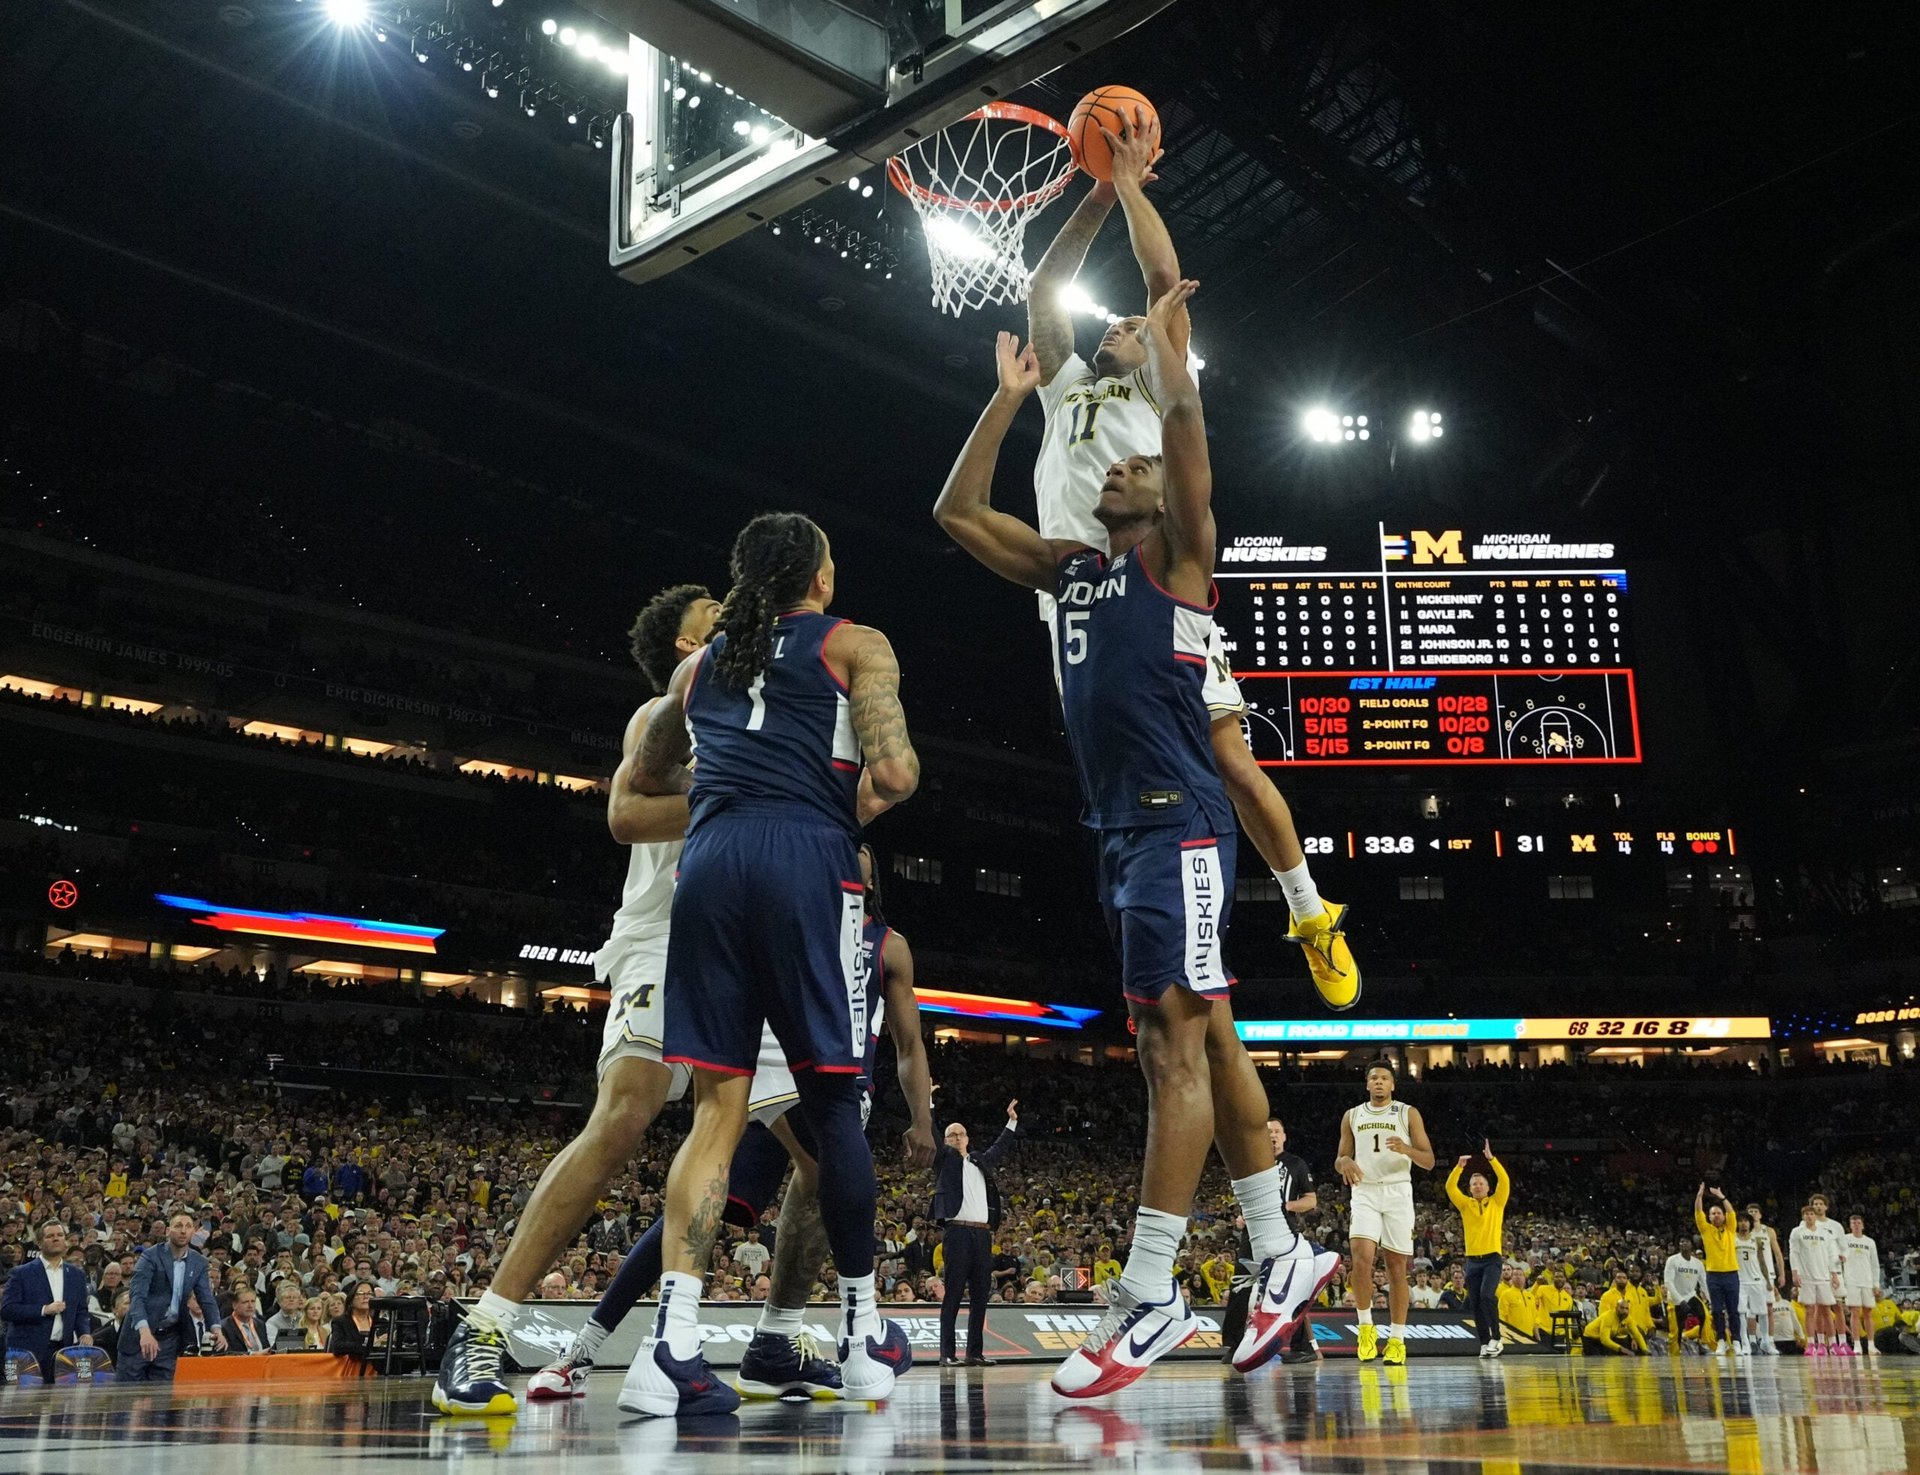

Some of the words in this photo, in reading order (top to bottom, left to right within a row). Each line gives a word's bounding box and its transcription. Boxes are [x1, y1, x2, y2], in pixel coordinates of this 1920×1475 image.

[1069, 402, 1100, 447] 11
[1234, 536, 1283, 547] UCONN
[1483, 534, 1550, 544] MICHIGAN
[1411, 531, 1464, 564] M
[1473, 544, 1614, 559] WOLVERINES
[1222, 547, 1327, 562] HUSKIES
[1250, 583, 1265, 591] PTS
[1340, 582, 1355, 590] BLK
[1536, 580, 1551, 588] AST
[1558, 580, 1573, 588] STL
[1254, 597, 1263, 605] 4
[1276, 596, 1285, 605] 3
[1299, 596, 1307, 605] 3
[1321, 596, 1330, 605] 0
[1344, 596, 1353, 605] 0
[1367, 596, 1373, 604] 1
[1401, 596, 1405, 604] 1
[1417, 595, 1483, 604] MCKENNEY
[1495, 595, 1503, 603] 0
[1517, 594, 1525, 603] 5
[1541, 594, 1547, 603] 1
[1562, 594, 1571, 603] 0
[1584, 594, 1593, 603] 0
[1607, 593, 1616, 602] 0
[1277, 611, 1286, 620] 0
[1300, 611, 1308, 620] 0
[1322, 611, 1331, 620] 0
[1345, 611, 1354, 619] 0
[1367, 610, 1375, 619] 2
[1401, 611, 1408, 619] 11
[1417, 610, 1456, 619] GAYLE
[1457, 610, 1474, 619] JR.
[1496, 609, 1504, 618] 2
[1519, 609, 1525, 618] 1
[1541, 609, 1550, 618] 0
[1563, 609, 1572, 618] 0
[1587, 609, 1593, 617] 1
[1608, 608, 1617, 617] 0
[1256, 627, 1264, 635] 4
[1278, 626, 1286, 635] 6
[1300, 626, 1309, 635] 0
[1323, 626, 1332, 635] 0
[1346, 626, 1354, 634] 0
[1368, 625, 1376, 634] 2
[1400, 625, 1411, 634] 15
[1419, 625, 1455, 634] MARA
[1520, 624, 1528, 633] 2
[1543, 624, 1550, 633] 1
[1565, 624, 1574, 633] 0
[1589, 624, 1595, 632] 1
[1610, 623, 1619, 632] 0
[1065, 611, 1090, 665] 5
[1401, 640, 1412, 649] 21
[1419, 640, 1476, 649] JOHNSON
[1477, 640, 1493, 649] JR.
[1497, 639, 1509, 648] 10
[1521, 639, 1530, 648] 4
[1544, 639, 1553, 648] 0
[1567, 639, 1573, 648] 1
[1589, 638, 1598, 647] 0
[1613, 638, 1619, 647] 1
[32, 624, 112, 653] EDGERRIN
[116, 644, 168, 665] JAMES
[177, 656, 234, 678] 1999-05
[1279, 641, 1287, 650] 4
[1303, 641, 1308, 650] 1
[1324, 641, 1333, 650] 0
[1346, 641, 1355, 650] 0
[1370, 641, 1376, 649] 1
[1257, 657, 1265, 666] 3
[1279, 656, 1288, 665] 3
[1302, 656, 1311, 665] 0
[1324, 656, 1333, 665] 0
[1349, 656, 1355, 665] 1
[1371, 656, 1377, 664] 1
[1400, 655, 1415, 664] 23
[1421, 654, 1493, 664] LENDEBORG
[1500, 654, 1508, 663] 4
[1522, 654, 1531, 663] 0
[1545, 654, 1554, 663] 0
[1568, 654, 1577, 663] 0
[1590, 653, 1599, 662] 0
[1614, 653, 1620, 662] 1
[1349, 677, 1382, 690] 1ST
[1384, 677, 1436, 690] HALF
[326, 684, 359, 702] ERIC
[363, 691, 440, 717] DICKERSON
[1300, 698, 1350, 715] 10/30
[1359, 699, 1390, 709] FIELD
[1392, 699, 1429, 708] GOALS
[1438, 696, 1488, 714] 10/28
[1305, 718, 1347, 735] 5/15
[1363, 720, 1410, 729] 2-POINT
[1412, 720, 1428, 729] FG
[1439, 717, 1489, 734] 10/20
[1306, 738, 1348, 756] 5/15
[1364, 741, 1412, 750] 3-POINT
[1414, 741, 1430, 750] FG
[1447, 737, 1484, 755] 0/8
[1613, 832, 1633, 841] TOL
[1656, 832, 1675, 841] FLS
[1686, 832, 1720, 841] BONUS
[1304, 837, 1334, 854] 28
[1365, 837, 1414, 854] 33.6
[1448, 840, 1472, 849] 1ST
[1517, 836, 1543, 852] 31
[1571, 835, 1596, 852] M
[1618, 841, 1631, 854] 4
[1661, 841, 1674, 854] 4
[1192, 856, 1213, 981] HUSKIES
[519, 944, 558, 961] 2026
[614, 983, 656, 1022] M
[1855, 1010, 1896, 1025] 2026
[1244, 1025, 1285, 1037] THE
[1287, 1025, 1349, 1037] ROAD
[1352, 1024, 1409, 1037] ENDS
[1412, 1024, 1469, 1036] HERE
[1568, 1021, 1589, 1036] 68
[1596, 1021, 1625, 1036] 32
[1632, 1021, 1660, 1036] 16
[1667, 1020, 1690, 1036] 8
[1357, 1122, 1396, 1132] MICHIGAN
[1373, 1134, 1381, 1152] 1
[1742, 1251, 1749, 1261] 3
